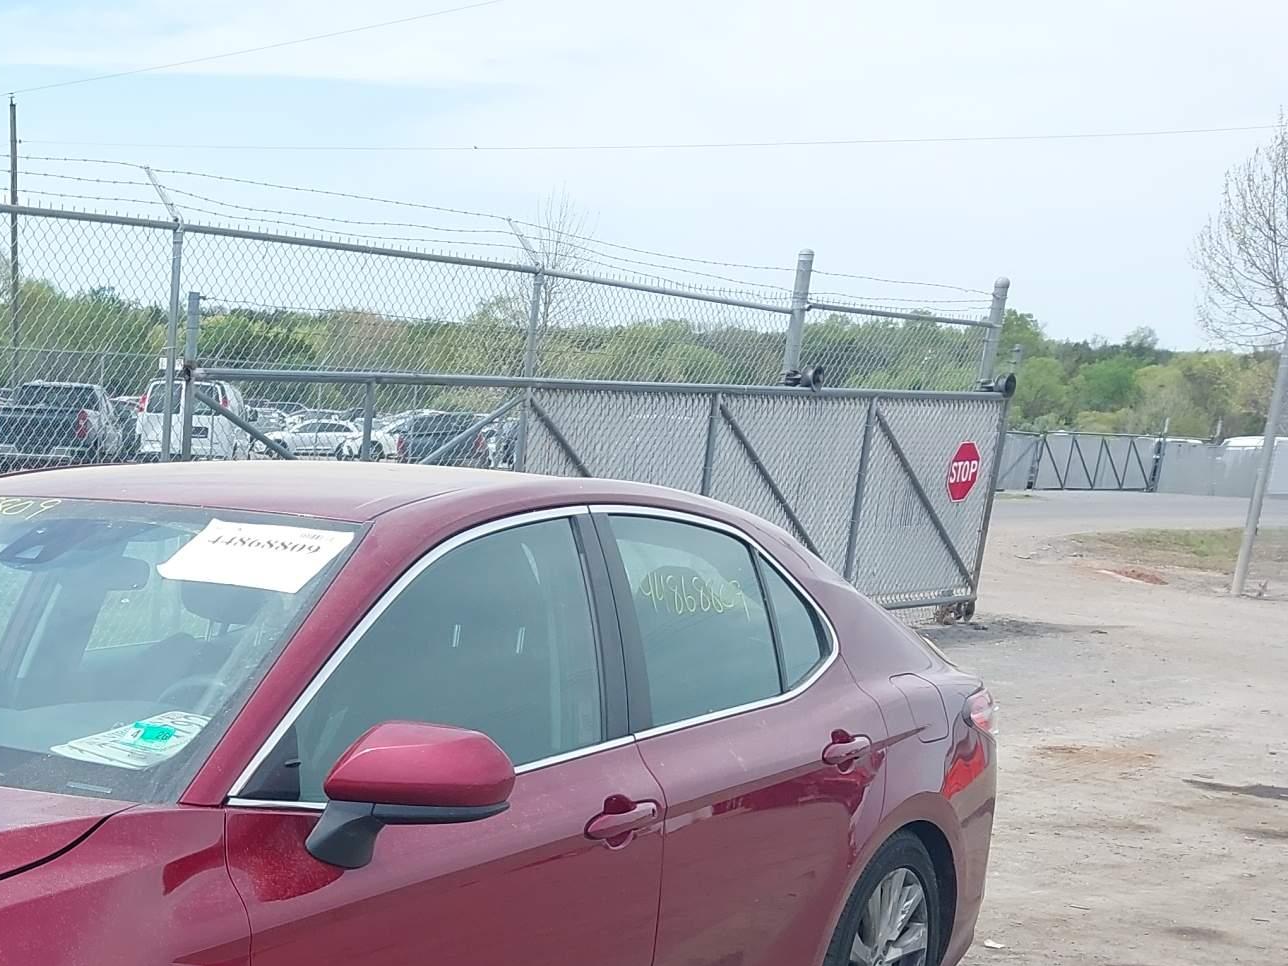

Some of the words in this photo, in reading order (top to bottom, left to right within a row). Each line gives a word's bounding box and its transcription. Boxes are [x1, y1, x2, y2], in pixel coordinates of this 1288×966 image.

[949, 460, 978, 483] STOP
[208, 534, 321, 554] 44868809
[639, 571, 751, 623] 44868809
